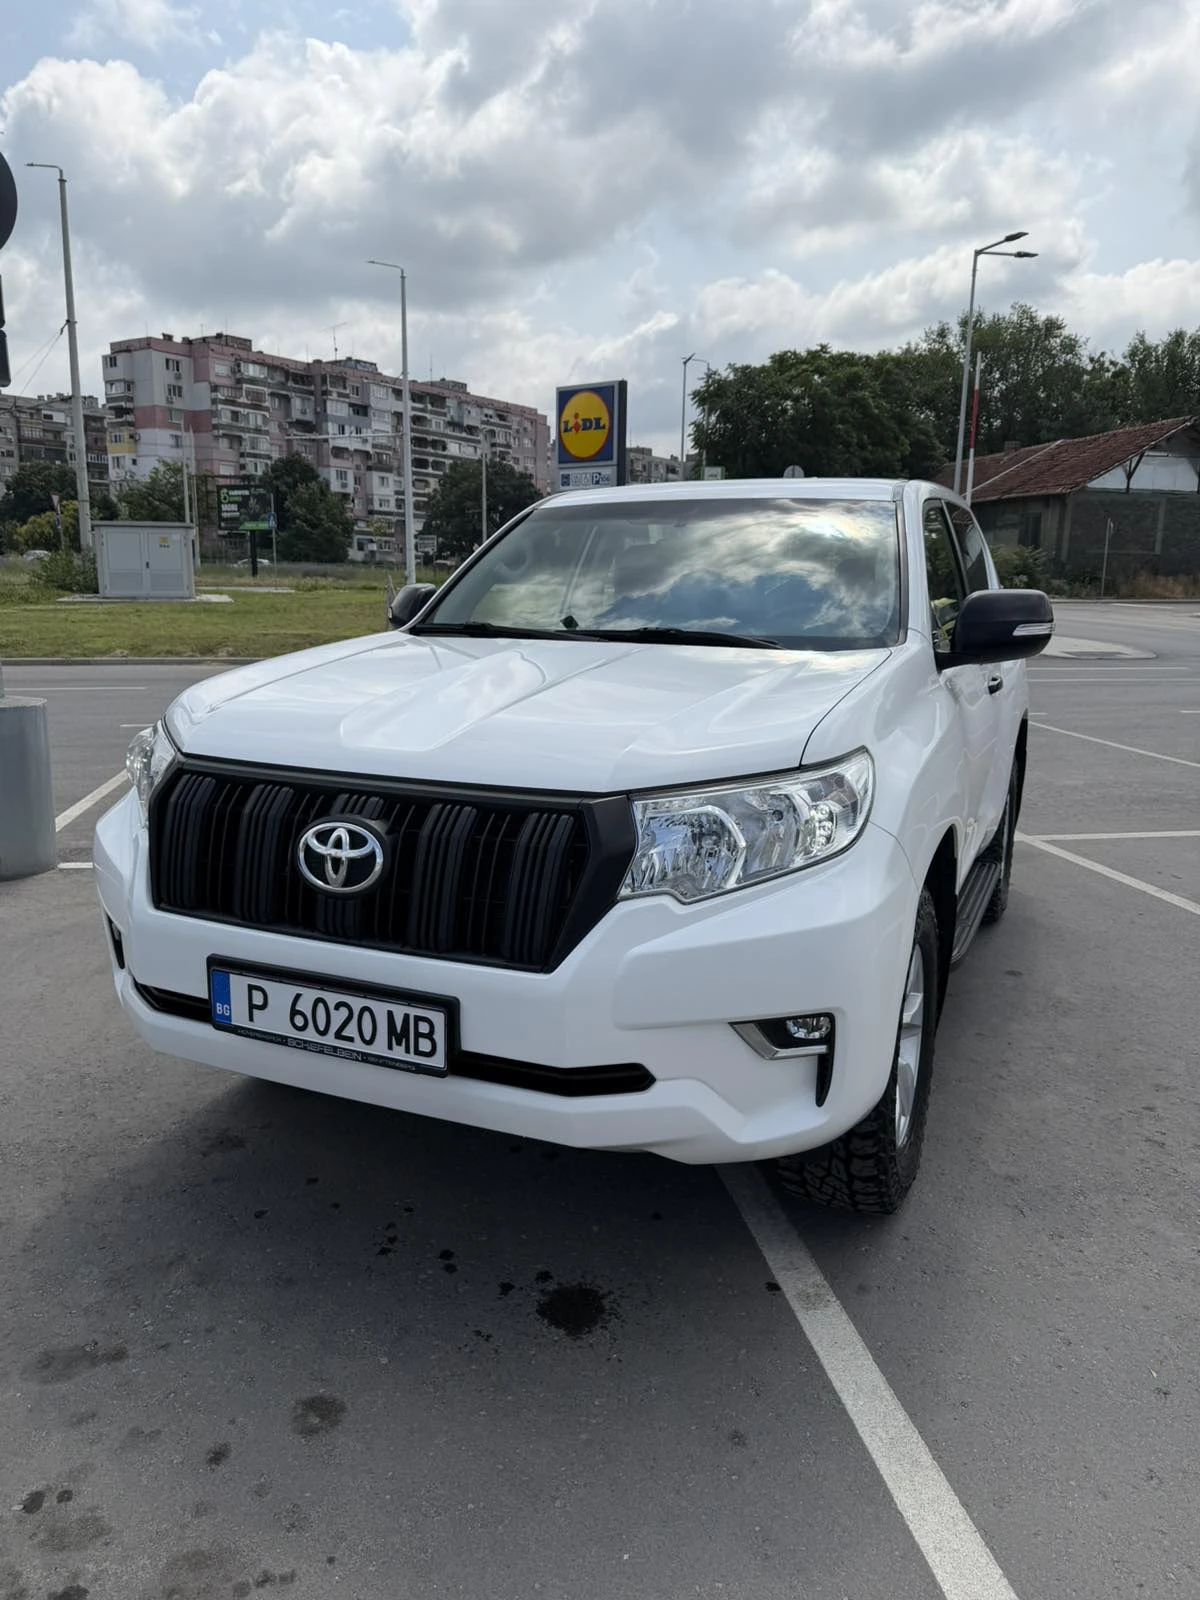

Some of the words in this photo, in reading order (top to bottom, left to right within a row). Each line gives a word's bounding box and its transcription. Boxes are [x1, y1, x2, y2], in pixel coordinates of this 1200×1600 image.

[216, 1002, 230, 1016] BG
[247, 983, 269, 1023] P
[289, 992, 378, 1046] 6020
[386, 1009, 437, 1058] MB
